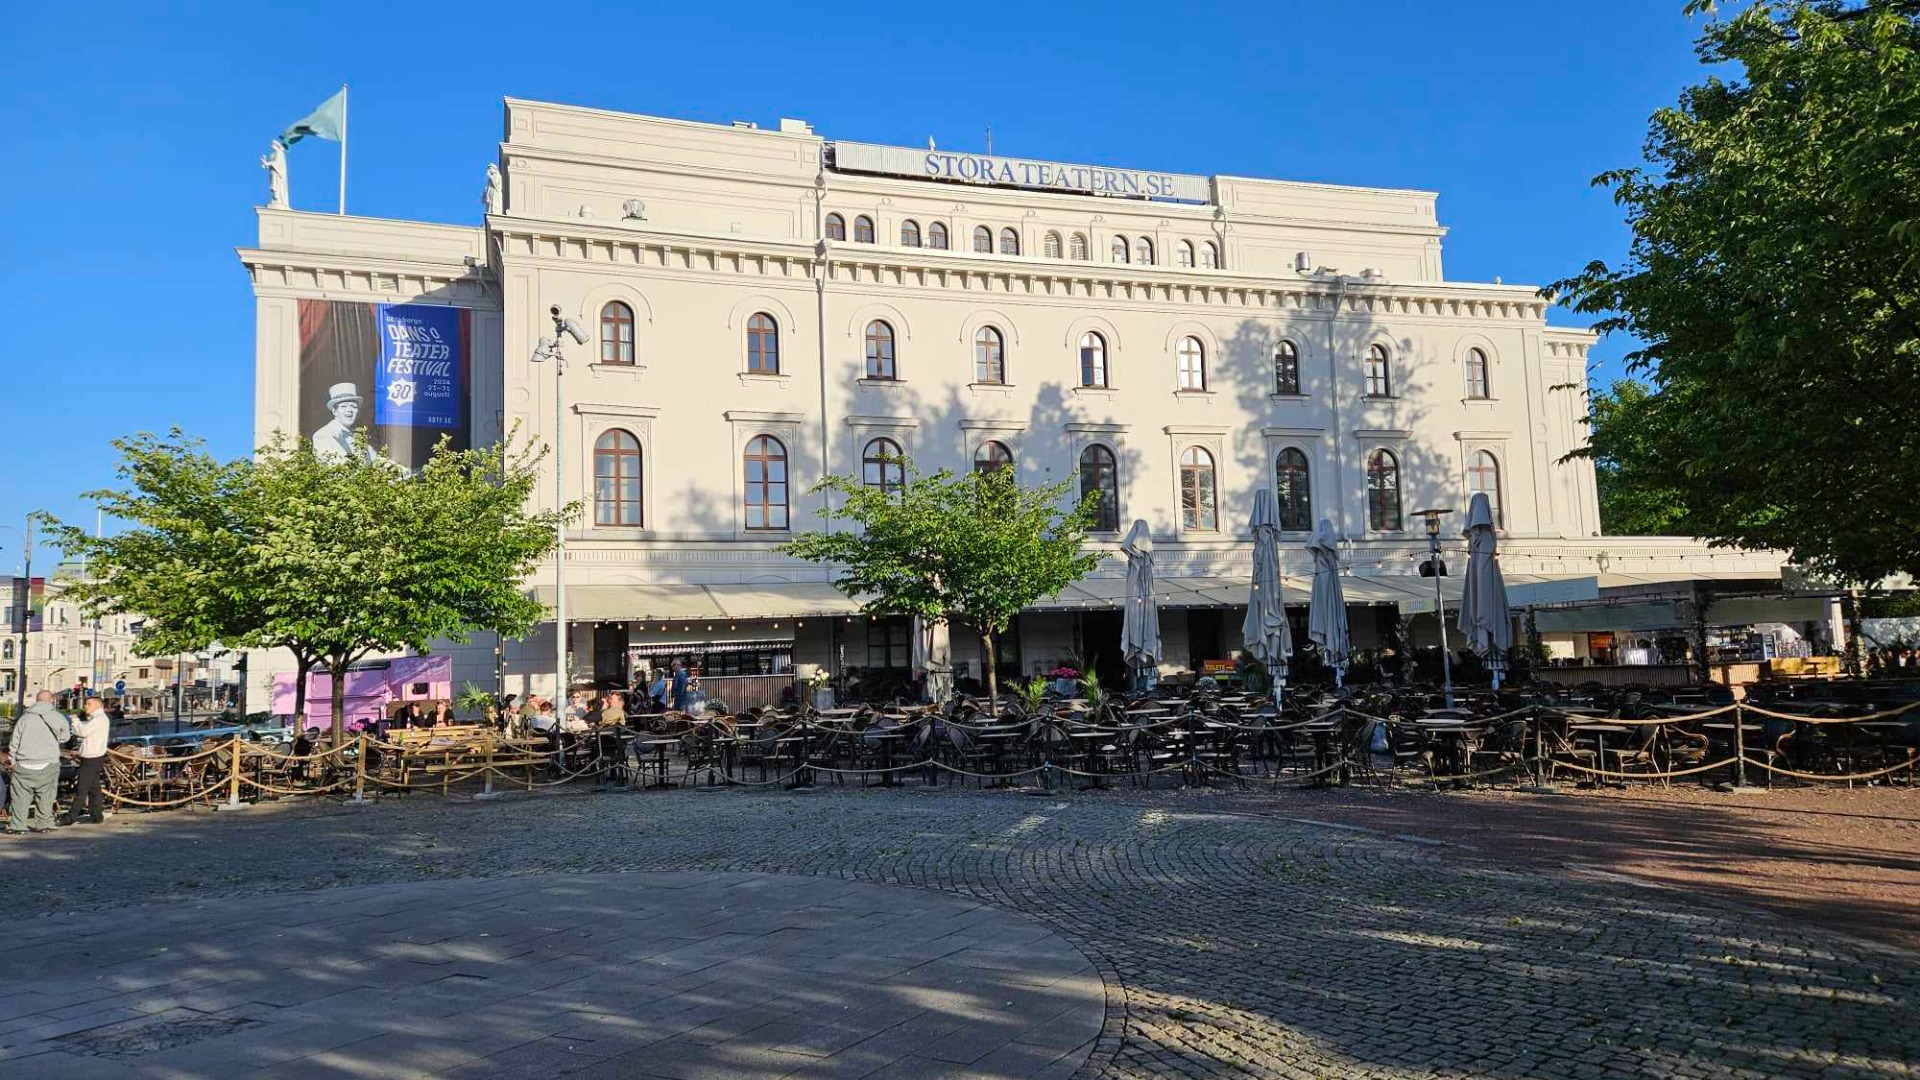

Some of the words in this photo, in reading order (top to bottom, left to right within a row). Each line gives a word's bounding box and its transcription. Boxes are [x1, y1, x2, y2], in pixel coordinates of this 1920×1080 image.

[387, 324, 431, 342] DANS
[392, 341, 450, 360] TEATER
[387, 358, 451, 377] FESTIVAL
[391, 383, 412, 400] 30
